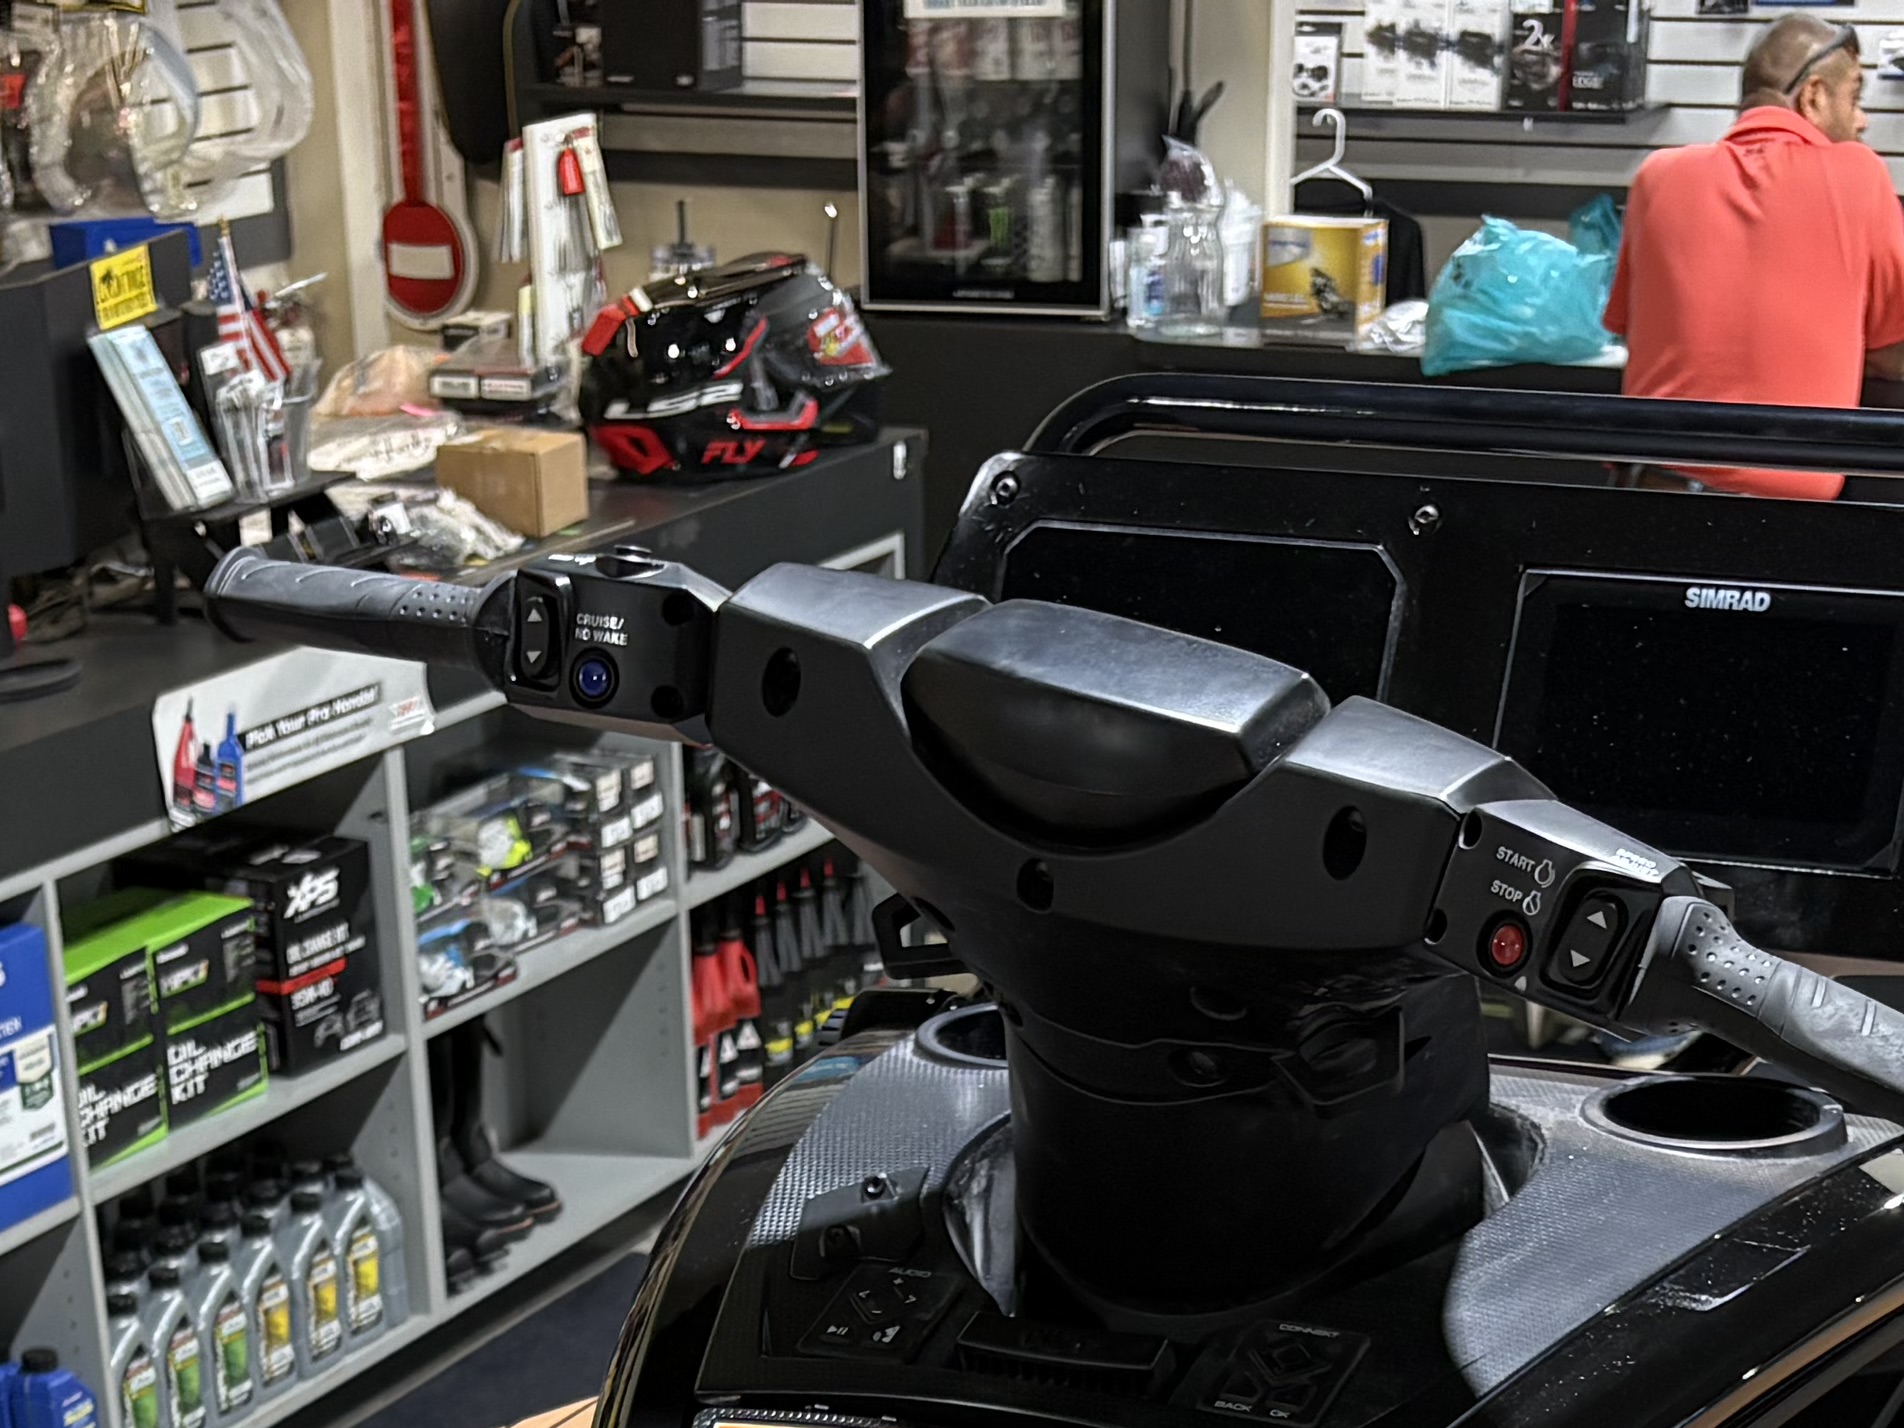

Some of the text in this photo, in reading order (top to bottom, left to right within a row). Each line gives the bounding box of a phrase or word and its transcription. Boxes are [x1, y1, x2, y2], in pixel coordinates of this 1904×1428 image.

[604, 379, 744, 419] LS2
[700, 438, 768, 465] FLY
[1684, 586, 1771, 613] SIMRAD
[576, 612, 625, 630] CRUISE/
[575, 627, 628, 646] NO WAKE
[1496, 845, 1536, 873] START
[1490, 879, 1523, 903] STOP
[166, 1038, 207, 1068] OIL
[169, 1029, 258, 1086] CHANGE
[170, 1071, 209, 1105] KIT
[1214, 1400, 1253, 1413] BACK
